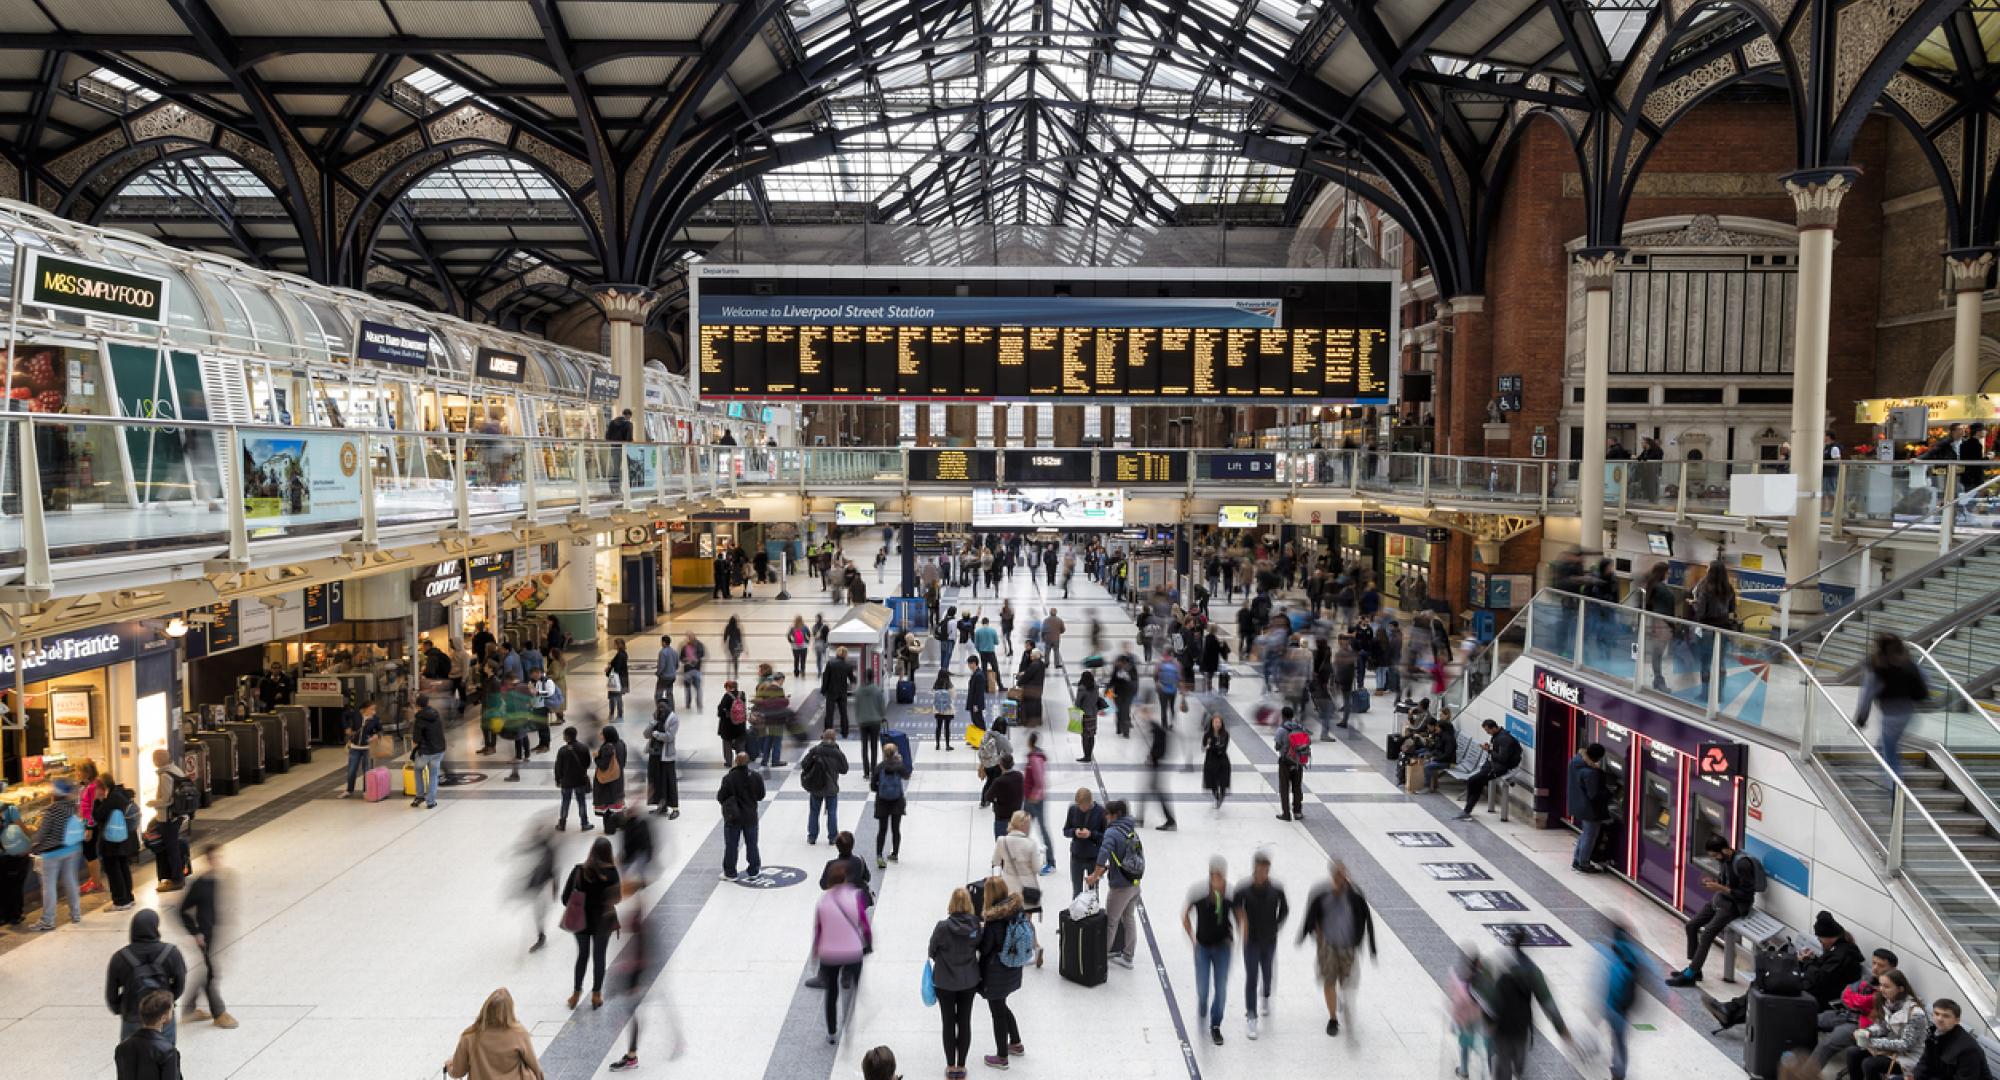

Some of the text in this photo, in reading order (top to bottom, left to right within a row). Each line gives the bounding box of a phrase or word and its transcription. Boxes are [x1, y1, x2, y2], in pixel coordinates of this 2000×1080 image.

[44, 271, 76, 294] M&S
[721, 304, 936, 320] Welcome to Liverpool Street Station
[1227, 462, 1242, 471] Lift
[332, 582, 341, 603] 5
[425, 575, 462, 598] COFFEE
[63, 634, 120, 660] France
[1545, 674, 1580, 706] NatWest
